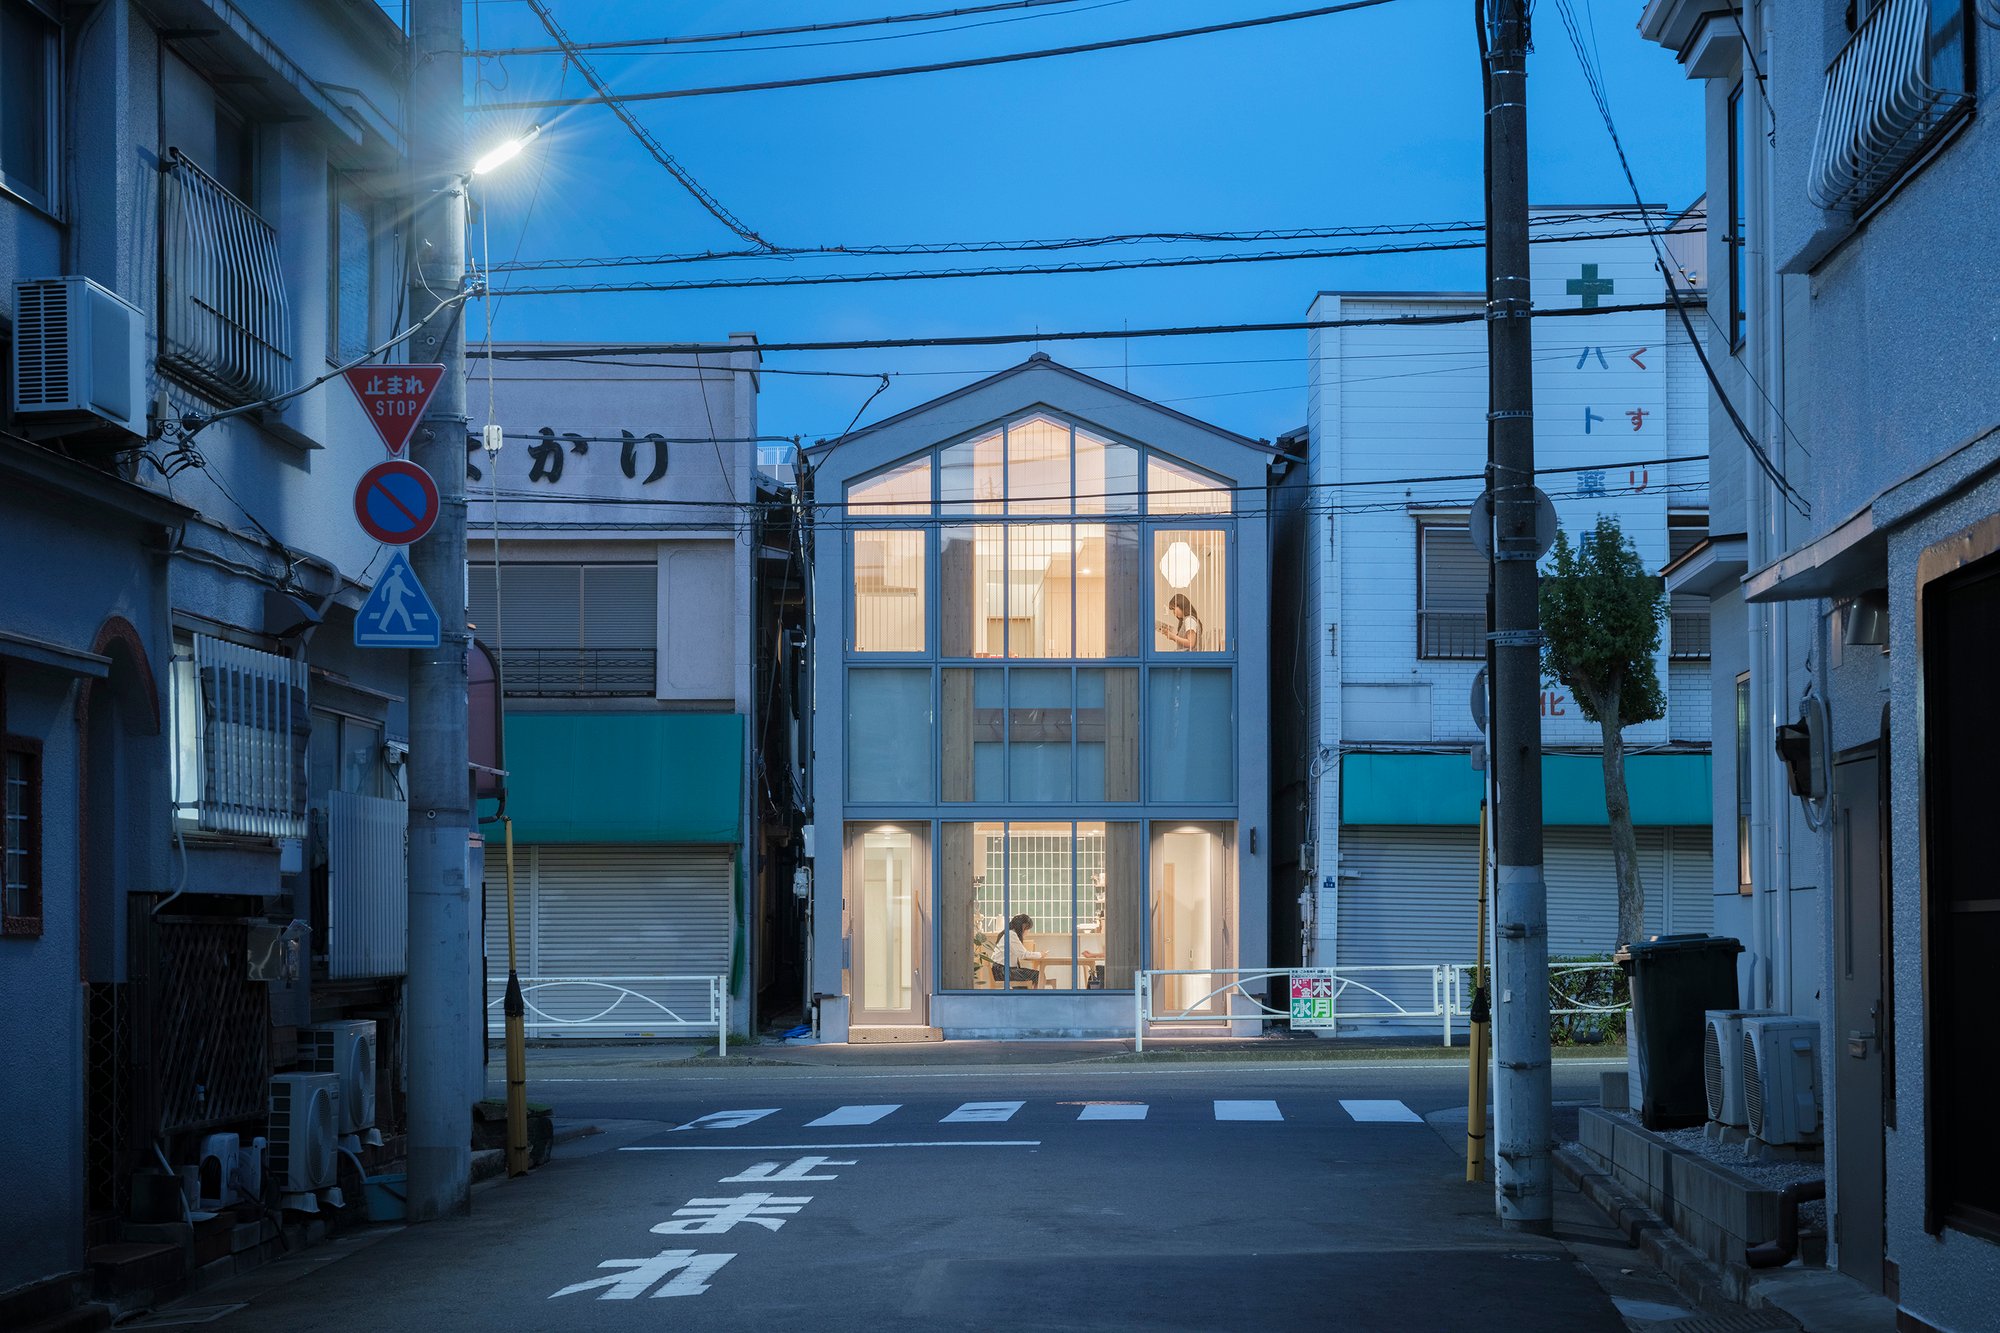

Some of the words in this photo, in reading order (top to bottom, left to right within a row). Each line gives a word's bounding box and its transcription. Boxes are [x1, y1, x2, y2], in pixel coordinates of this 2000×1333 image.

[365, 375, 425, 395] 止まれ
[375, 400, 417, 416] STOP
[1625, 347, 1650, 493] くすり
[1312, 979, 1332, 998] 木
[1293, 1000, 1311, 1018] 水
[1313, 1000, 1331, 1018] 月
[546, 1156, 859, 1300] 止まれ
